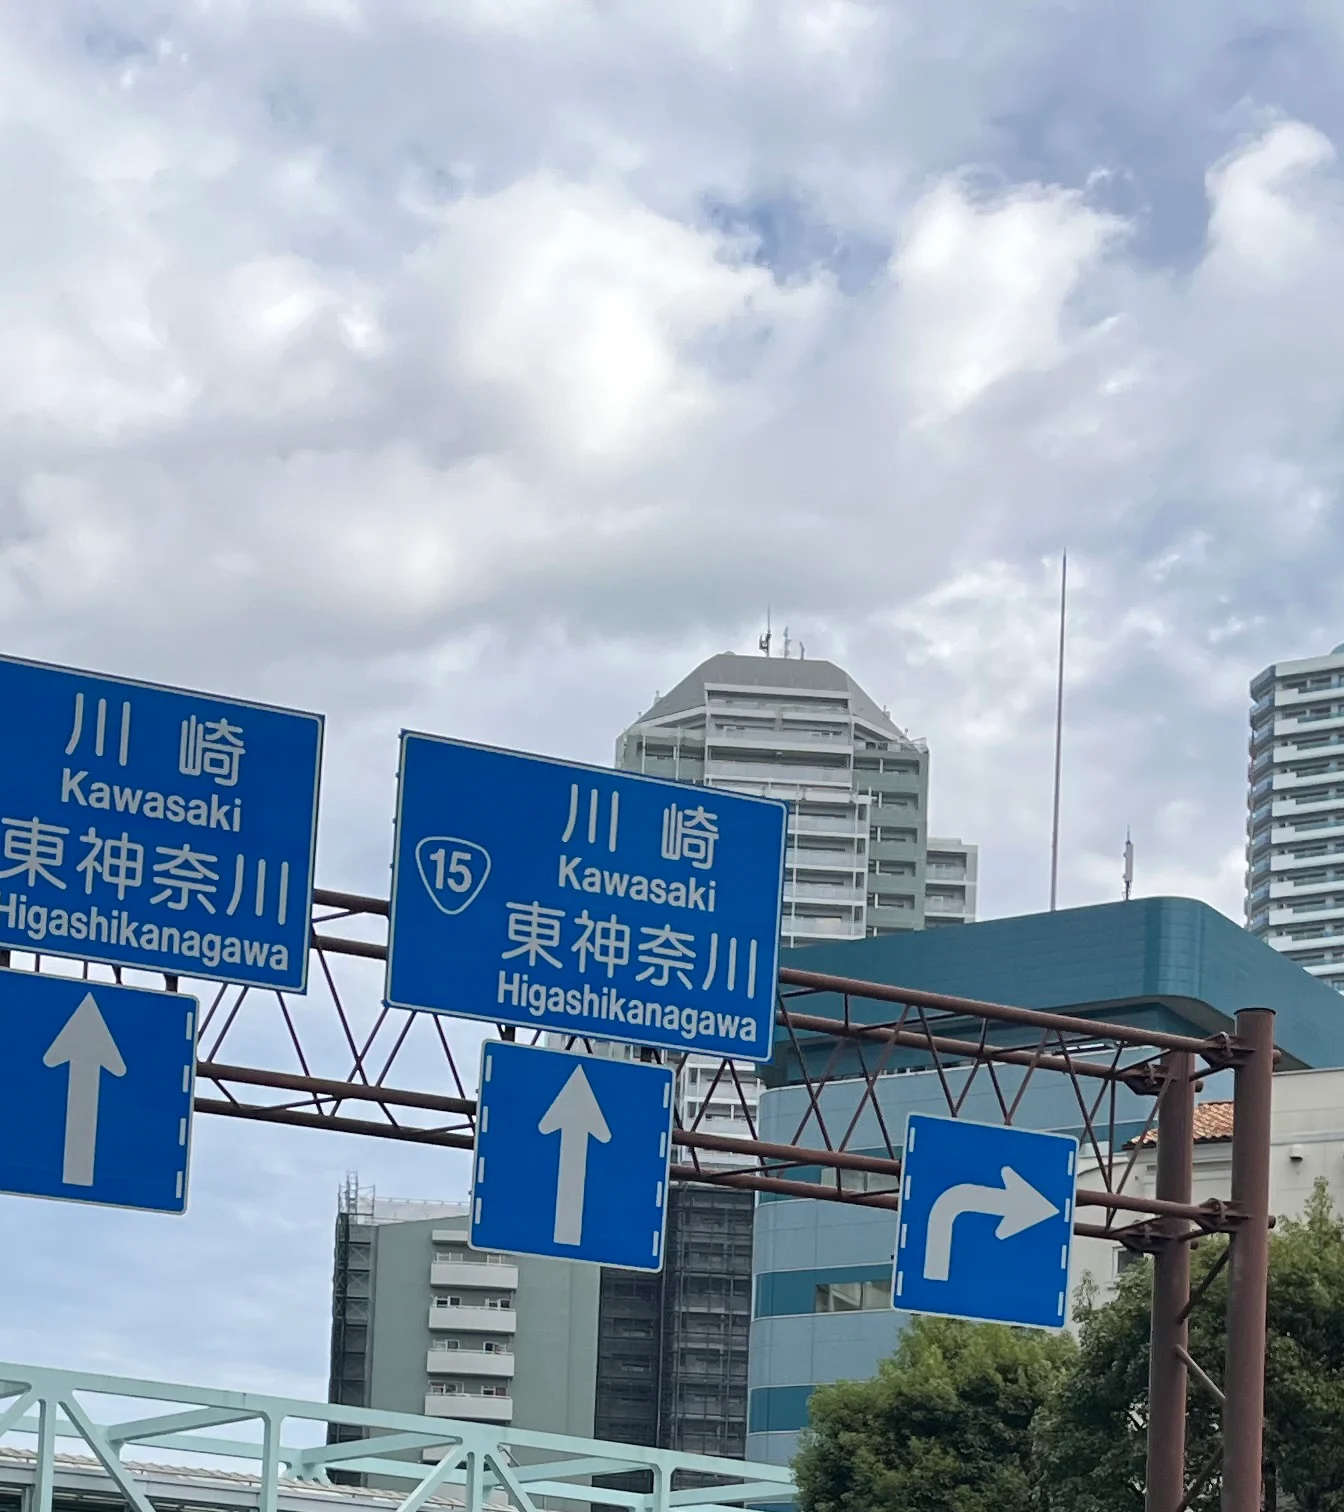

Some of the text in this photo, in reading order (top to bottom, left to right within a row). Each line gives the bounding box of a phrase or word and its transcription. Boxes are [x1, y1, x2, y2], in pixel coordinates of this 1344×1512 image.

[61, 767, 242, 833] Kawasaki
[429, 847, 472, 893] 15
[558, 854, 717, 913] Kawasaki
[501, 900, 758, 1000] 東神奈川
[497, 969, 758, 1043] Higashikanagawa
